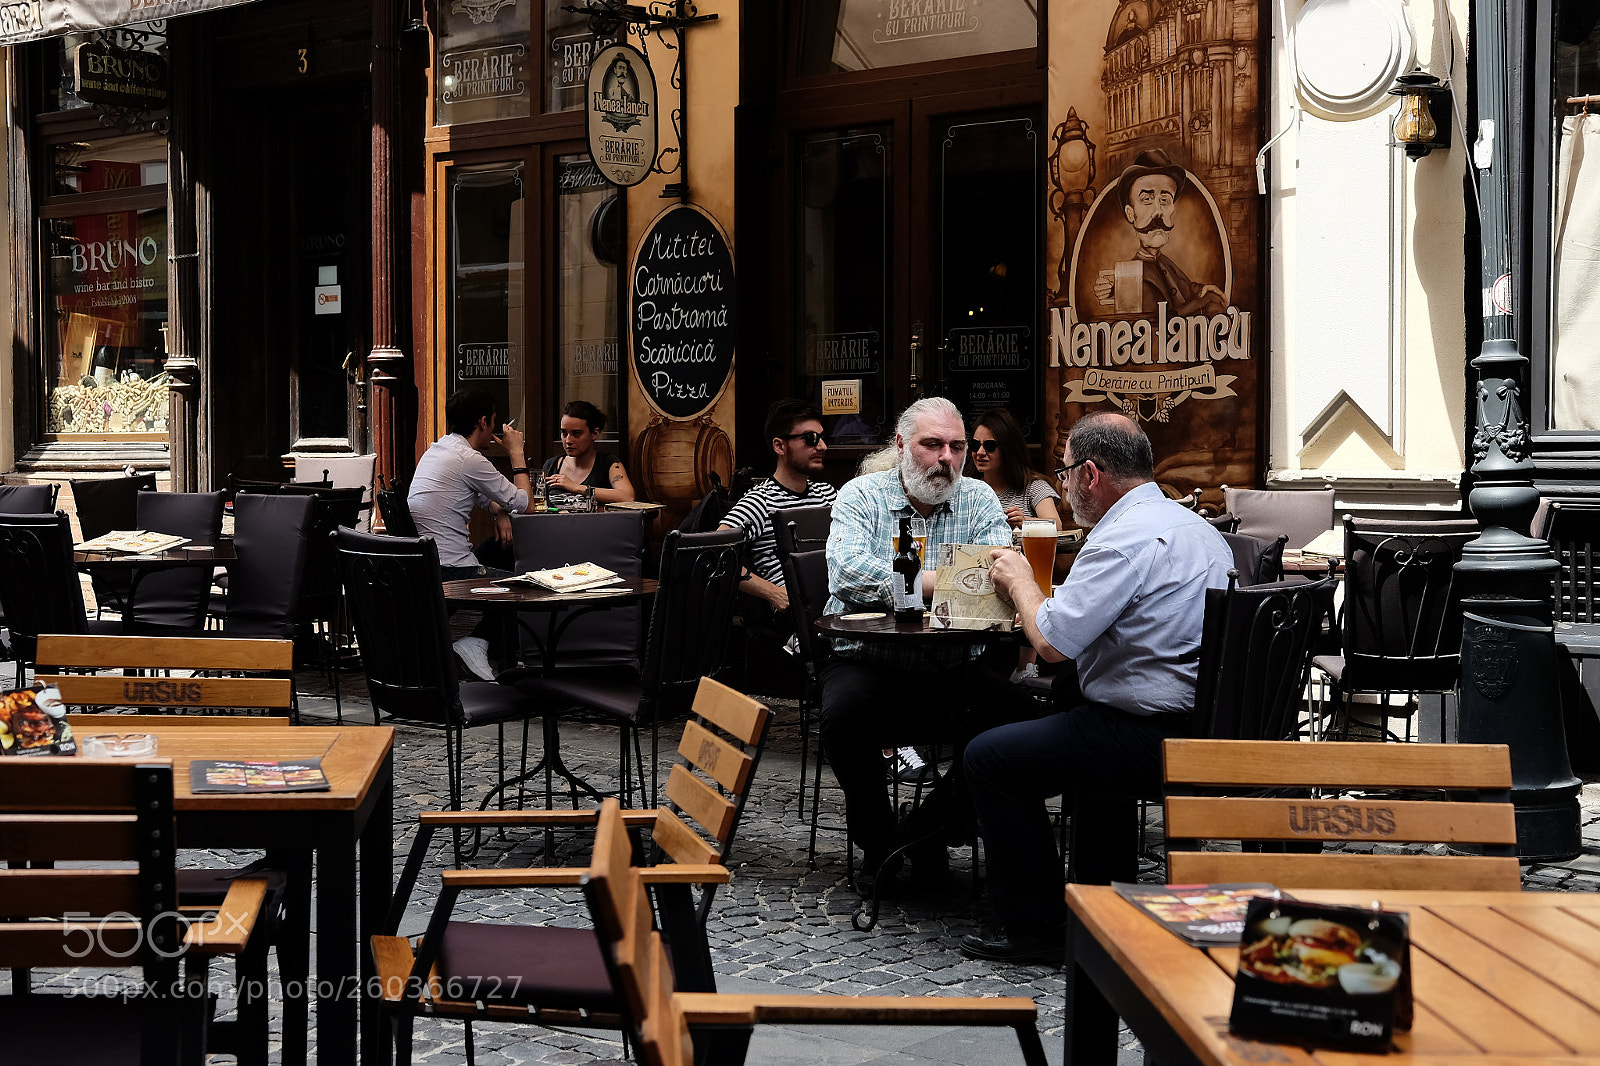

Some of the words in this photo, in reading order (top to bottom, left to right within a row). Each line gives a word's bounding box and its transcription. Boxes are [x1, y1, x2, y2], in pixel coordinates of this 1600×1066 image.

[885, 20, 899, 36] CU
[86, 52, 160, 82] BRUNO
[298, 48, 308, 74] 3
[454, 51, 514, 82] BERĂRIE
[562, 68, 574, 83] CU
[594, 91, 621, 114] Nenea
[605, 139, 640, 156] BERĂRIE
[70, 236, 157, 273] BRUNO
[648, 230, 715, 260] Mititei
[73, 281, 94, 294] wine
[95, 276, 110, 292] bar
[112, 278, 128, 290] and
[129, 276, 155, 290] bistro
[637, 301, 728, 330] Pastramă
[960, 329, 1019, 354] BERĂRIE
[1049, 306, 1154, 368] Nenea
[1155, 300, 1252, 364] Iancu
[466, 345, 509, 366] BERĂRIE
[639, 336, 717, 364] Scăricică
[816, 336, 869, 359] BERĂRIE
[585, 360, 618, 373] PRINTIPU
[958, 355, 969, 367] CU
[972, 353, 1020, 367] PRINTIPURI
[651, 370, 710, 399] Pizza
[992, 391, 1011, 399] 01:00
[1139, 380, 1152, 390] cu
[123, 680, 203, 704] URSUS
[1288, 804, 1397, 837] URSUS
